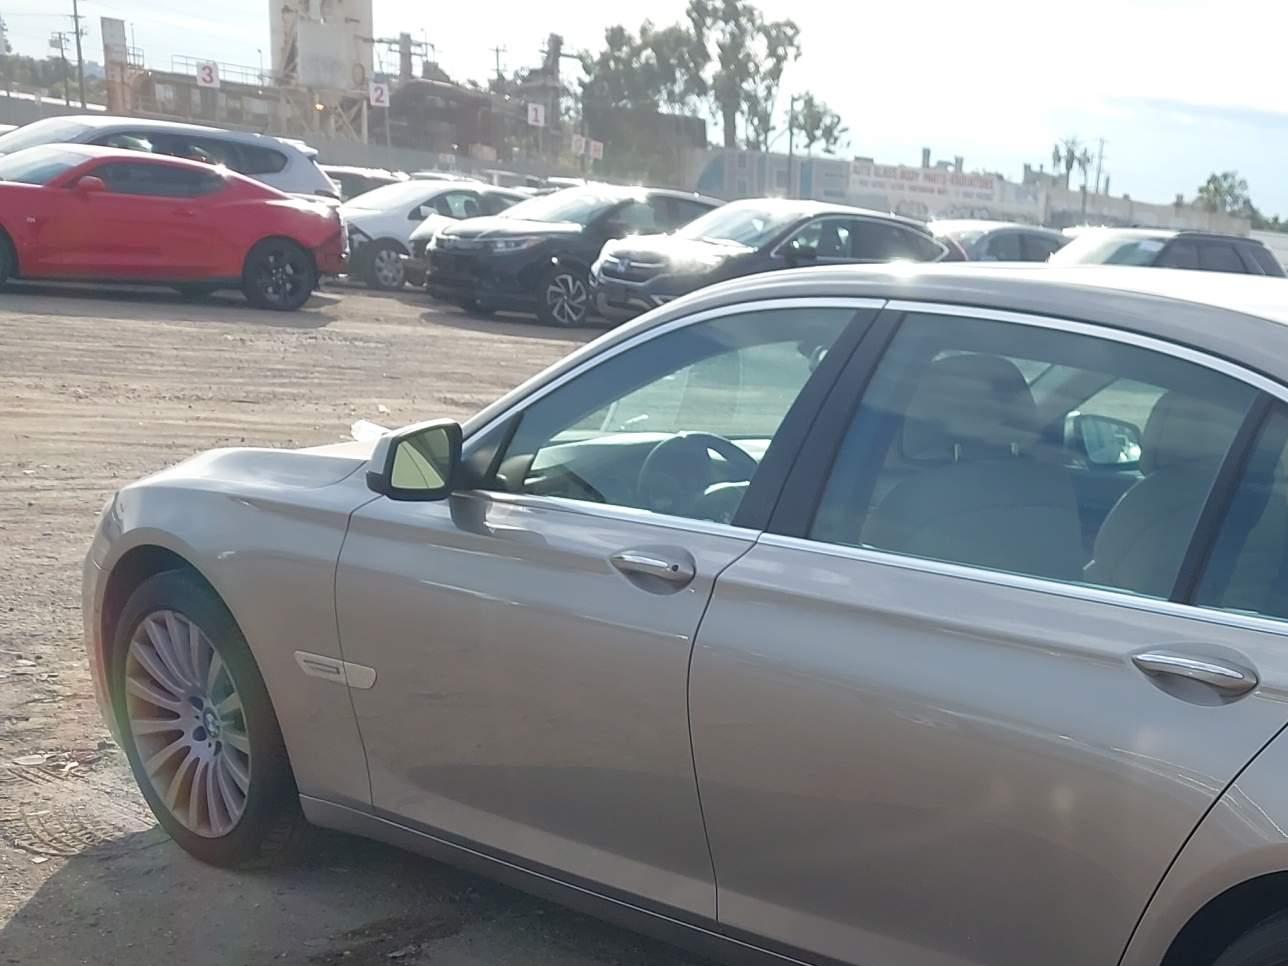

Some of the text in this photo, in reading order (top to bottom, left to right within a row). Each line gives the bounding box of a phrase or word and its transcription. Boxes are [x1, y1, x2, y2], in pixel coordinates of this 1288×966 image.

[202, 65, 214, 84] 3
[374, 86, 385, 104] 2
[531, 107, 541, 122] 1
